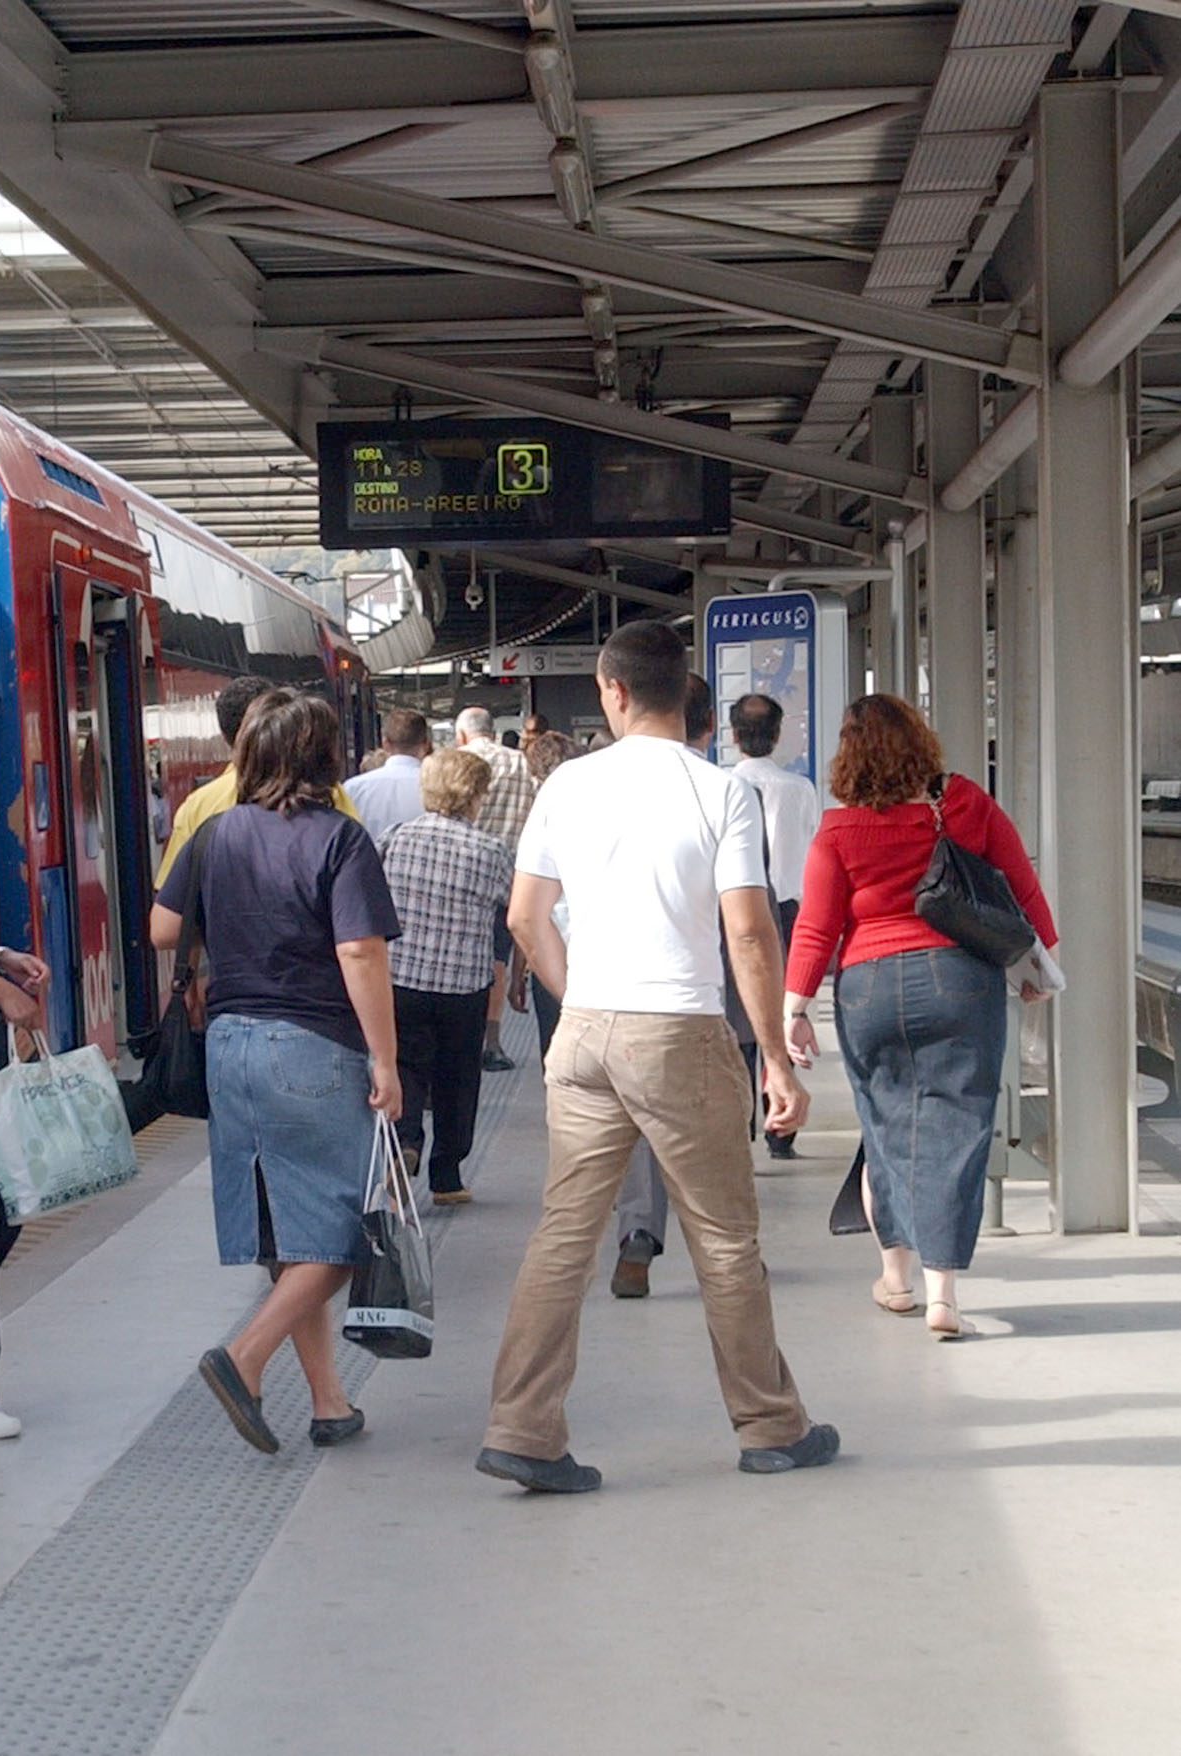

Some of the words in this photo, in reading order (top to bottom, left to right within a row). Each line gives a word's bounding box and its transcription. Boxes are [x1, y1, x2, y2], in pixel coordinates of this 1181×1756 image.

[353, 448, 383, 461] HORA
[512, 451, 534, 489] 3
[353, 482, 399, 495] DESTINO
[712, 610, 792, 629] FERTAGUS
[533, 655, 546, 672] 3
